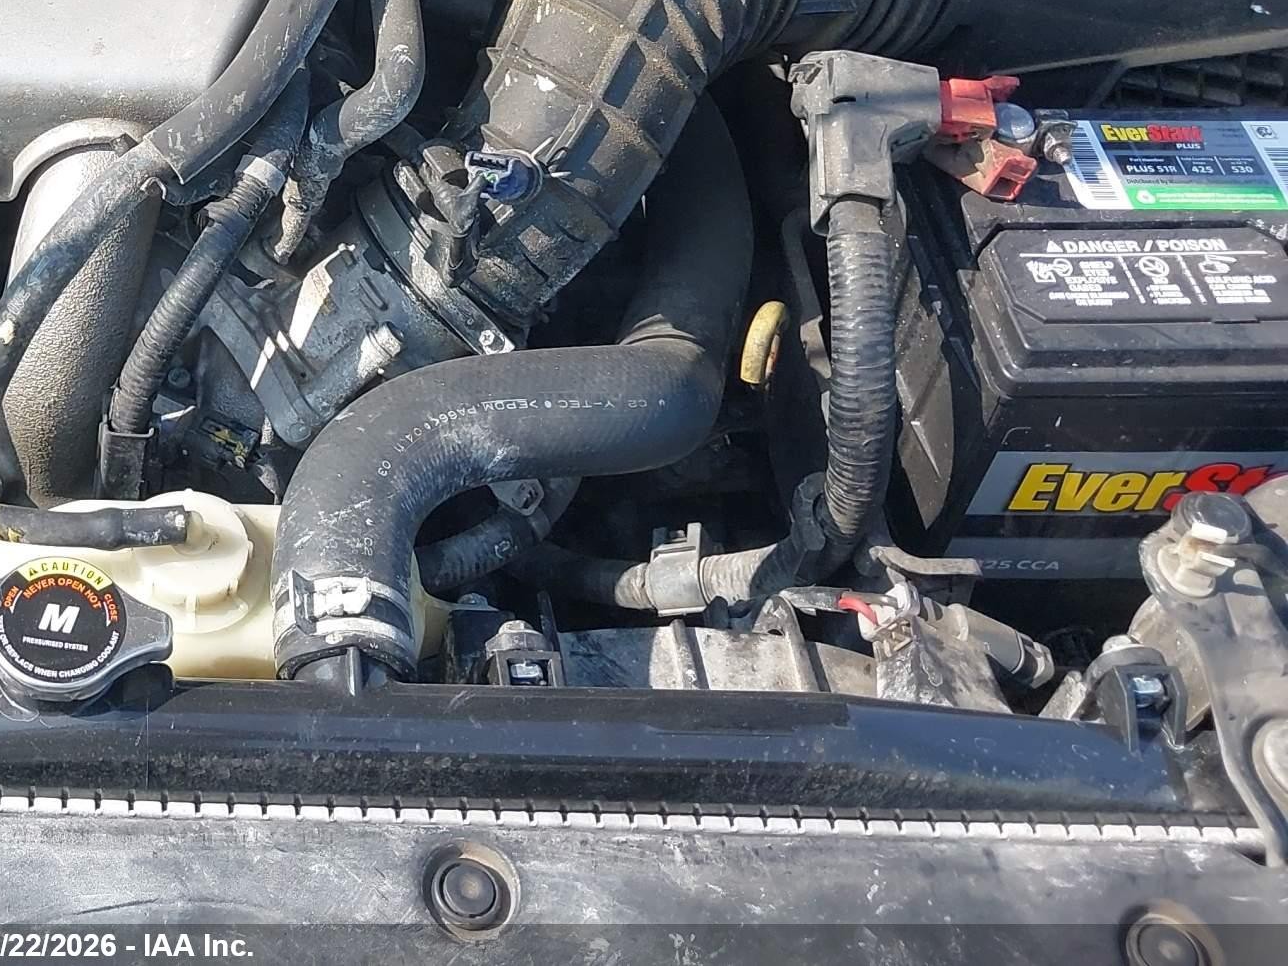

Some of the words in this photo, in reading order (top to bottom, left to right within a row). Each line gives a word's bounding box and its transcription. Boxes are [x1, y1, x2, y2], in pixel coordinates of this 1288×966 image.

[1100, 123, 1204, 142] EverStart
[1127, 165, 1154, 173] PLUS
[1156, 165, 1177, 173] 51R
[1192, 165, 1214, 173] 425
[1231, 165, 1254, 173] 530
[1062, 240, 1139, 253] DANGER
[1143, 239, 1154, 252] /
[1156, 238, 1228, 251] POISON
[1065, 276, 1119, 284] EXPLOSIVE
[558, 399, 616, 408] Y-TEC
[1008, 462, 1274, 513] EverSt
[41, 561, 105, 585] CAUTION
[978, 560, 1012, 570] 25
[1016, 560, 1060, 571] CCA
[3, 585, 20, 608] OPEN
[23, 577, 55, 599] NEVER
[57, 577, 86, 594] OPEN
[84, 588, 102, 610] HOT
[103, 593, 120, 622] CLOSE
[38, 603, 81, 634] M
[22, 636, 64, 649] PRESSURISED
[64, 641, 89, 652] SYSTEM
[4, 644, 34, 672] REPLACE
[34, 668, 58, 678] WHEN
[58, 660, 99, 679] CHANGING
[97, 631, 121, 664] COOLANT
